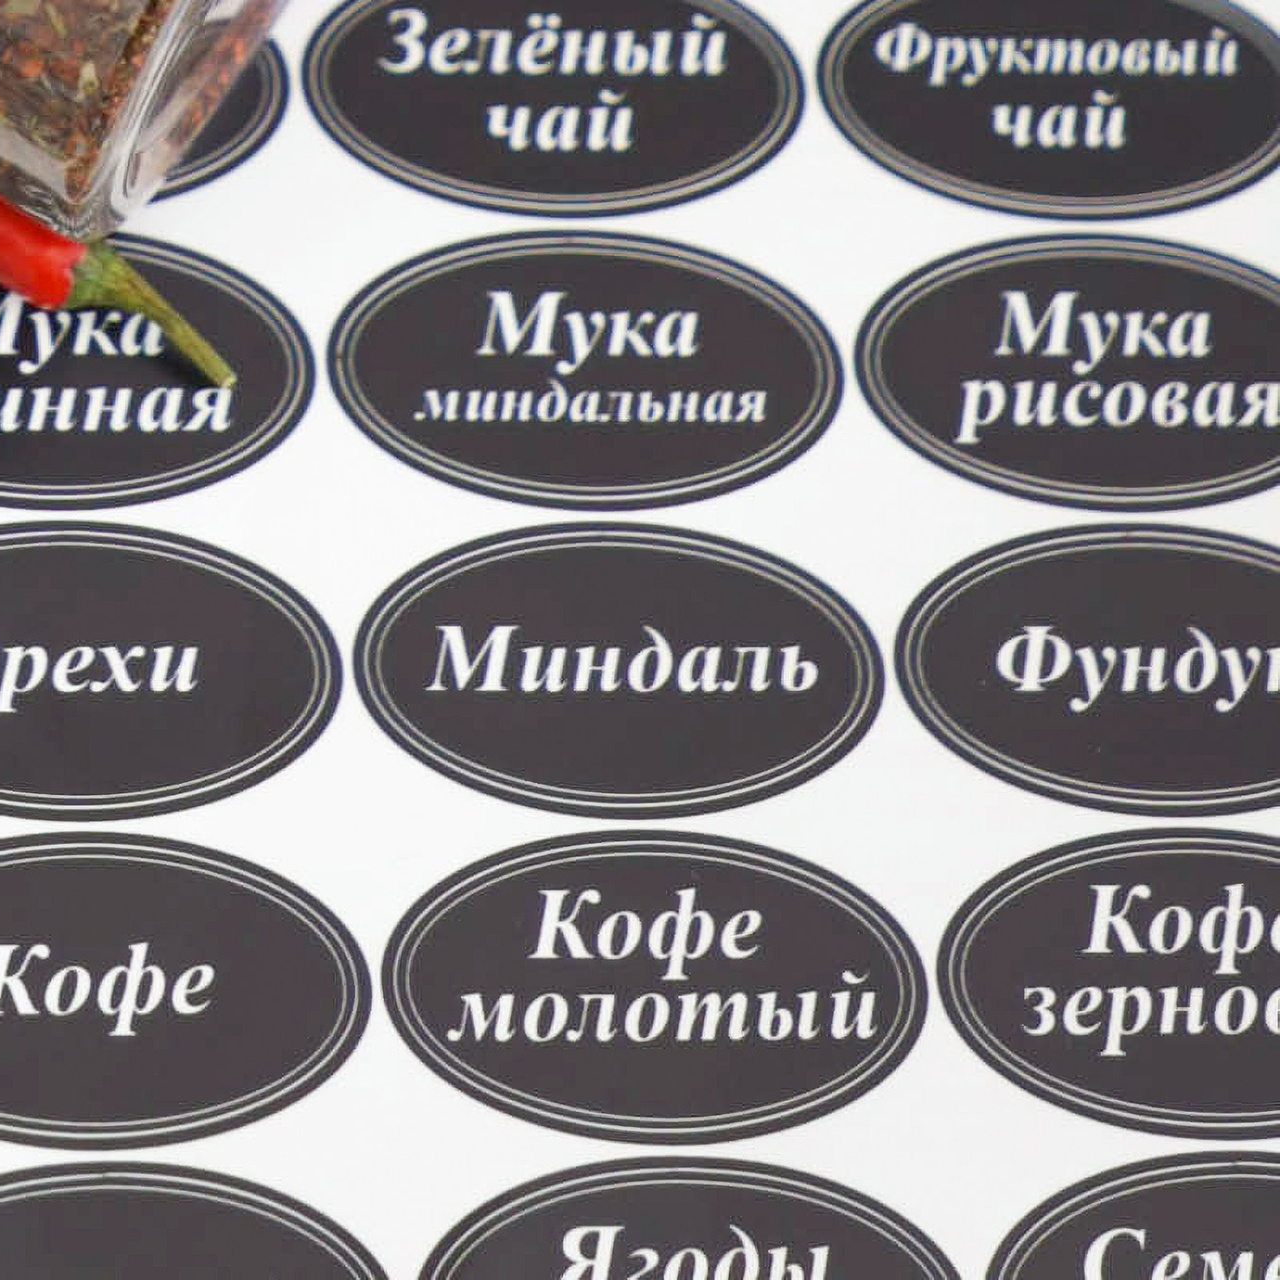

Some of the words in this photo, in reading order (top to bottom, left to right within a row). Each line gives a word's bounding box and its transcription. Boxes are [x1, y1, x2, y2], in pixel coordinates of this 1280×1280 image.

[380, 7, 726, 76] Зелёный
[875, 21, 1239, 86] Фруктовый
[487, 88, 633, 152] чай
[992, 88, 1126, 149] чай
[477, 290, 698, 374] Мука
[995, 289, 1211, 375] Мука
[414, 377, 768, 424] миндальная
[954, 377, 1280, 444] рисовая
[425, 624, 819, 693] Миндаль
[529, 887, 763, 981] Кофе
[1081, 883, 1280, 975] Коф
[446, 970, 877, 1043] молотый
